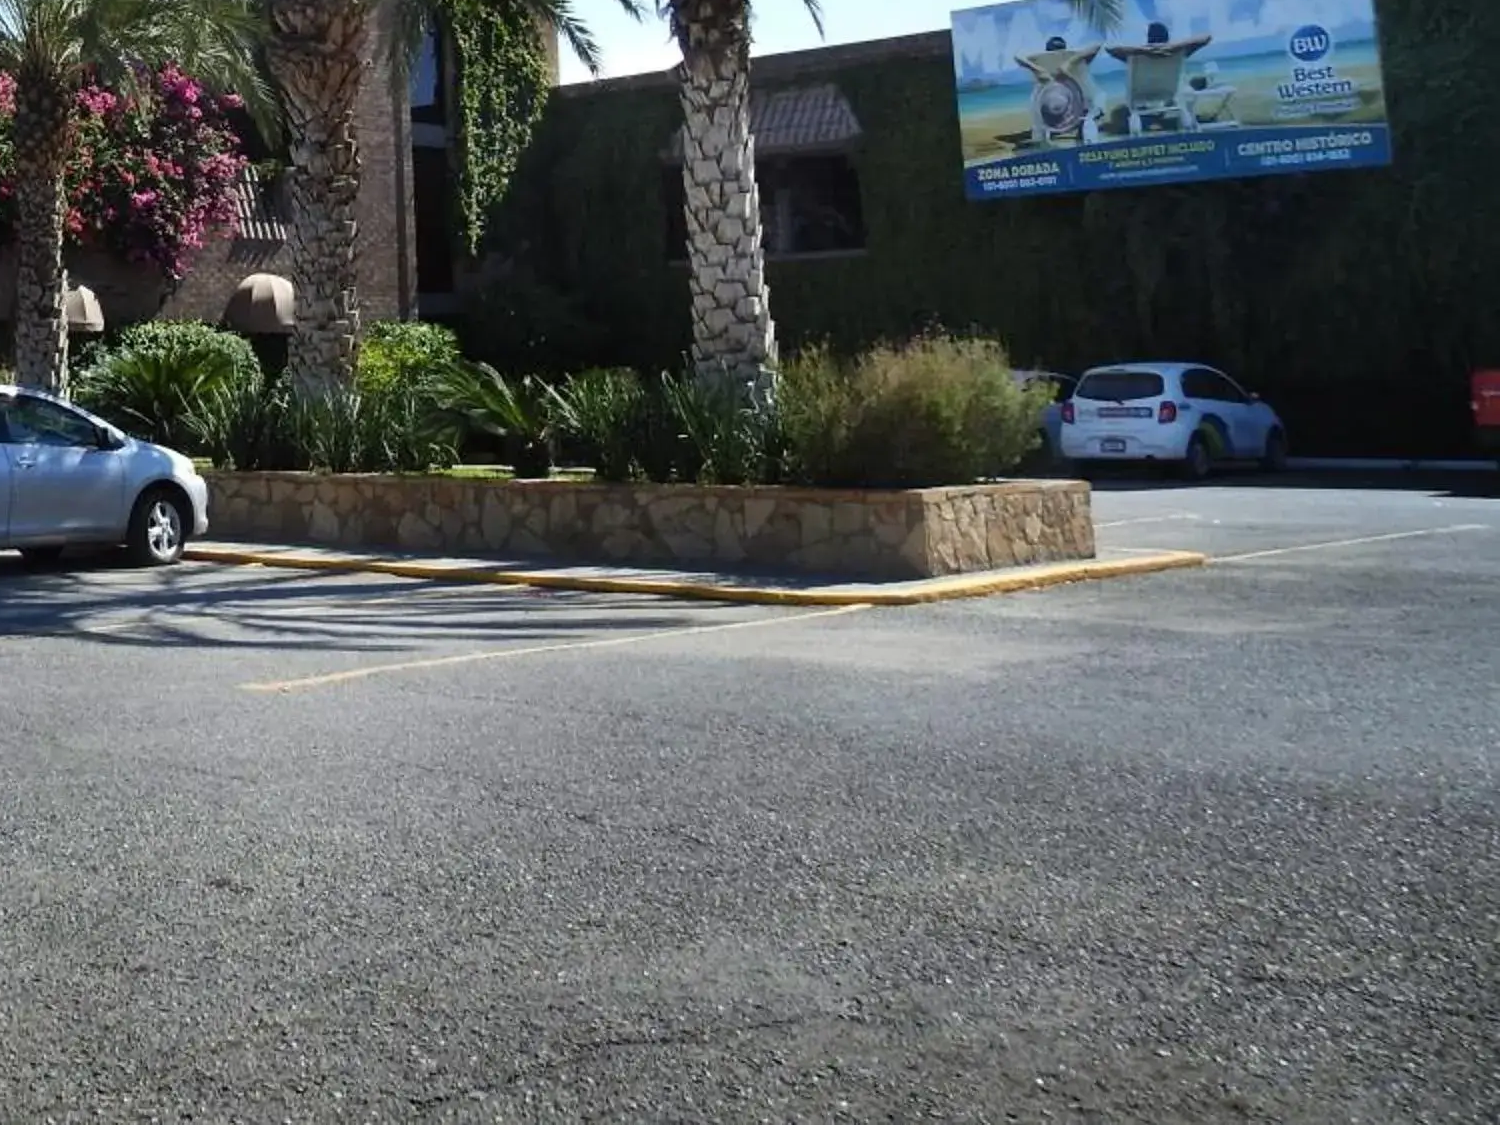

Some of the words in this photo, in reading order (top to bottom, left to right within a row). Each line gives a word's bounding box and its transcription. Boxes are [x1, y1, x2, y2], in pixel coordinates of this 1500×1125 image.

[1293, 34, 1327, 54] BW
[1293, 66, 1335, 82] Best
[1277, 80, 1352, 100] Western
[1238, 138, 1293, 156] CENTRO
[977, 166, 1010, 181] ZONA
[1011, 161, 1060, 177] DORADA
